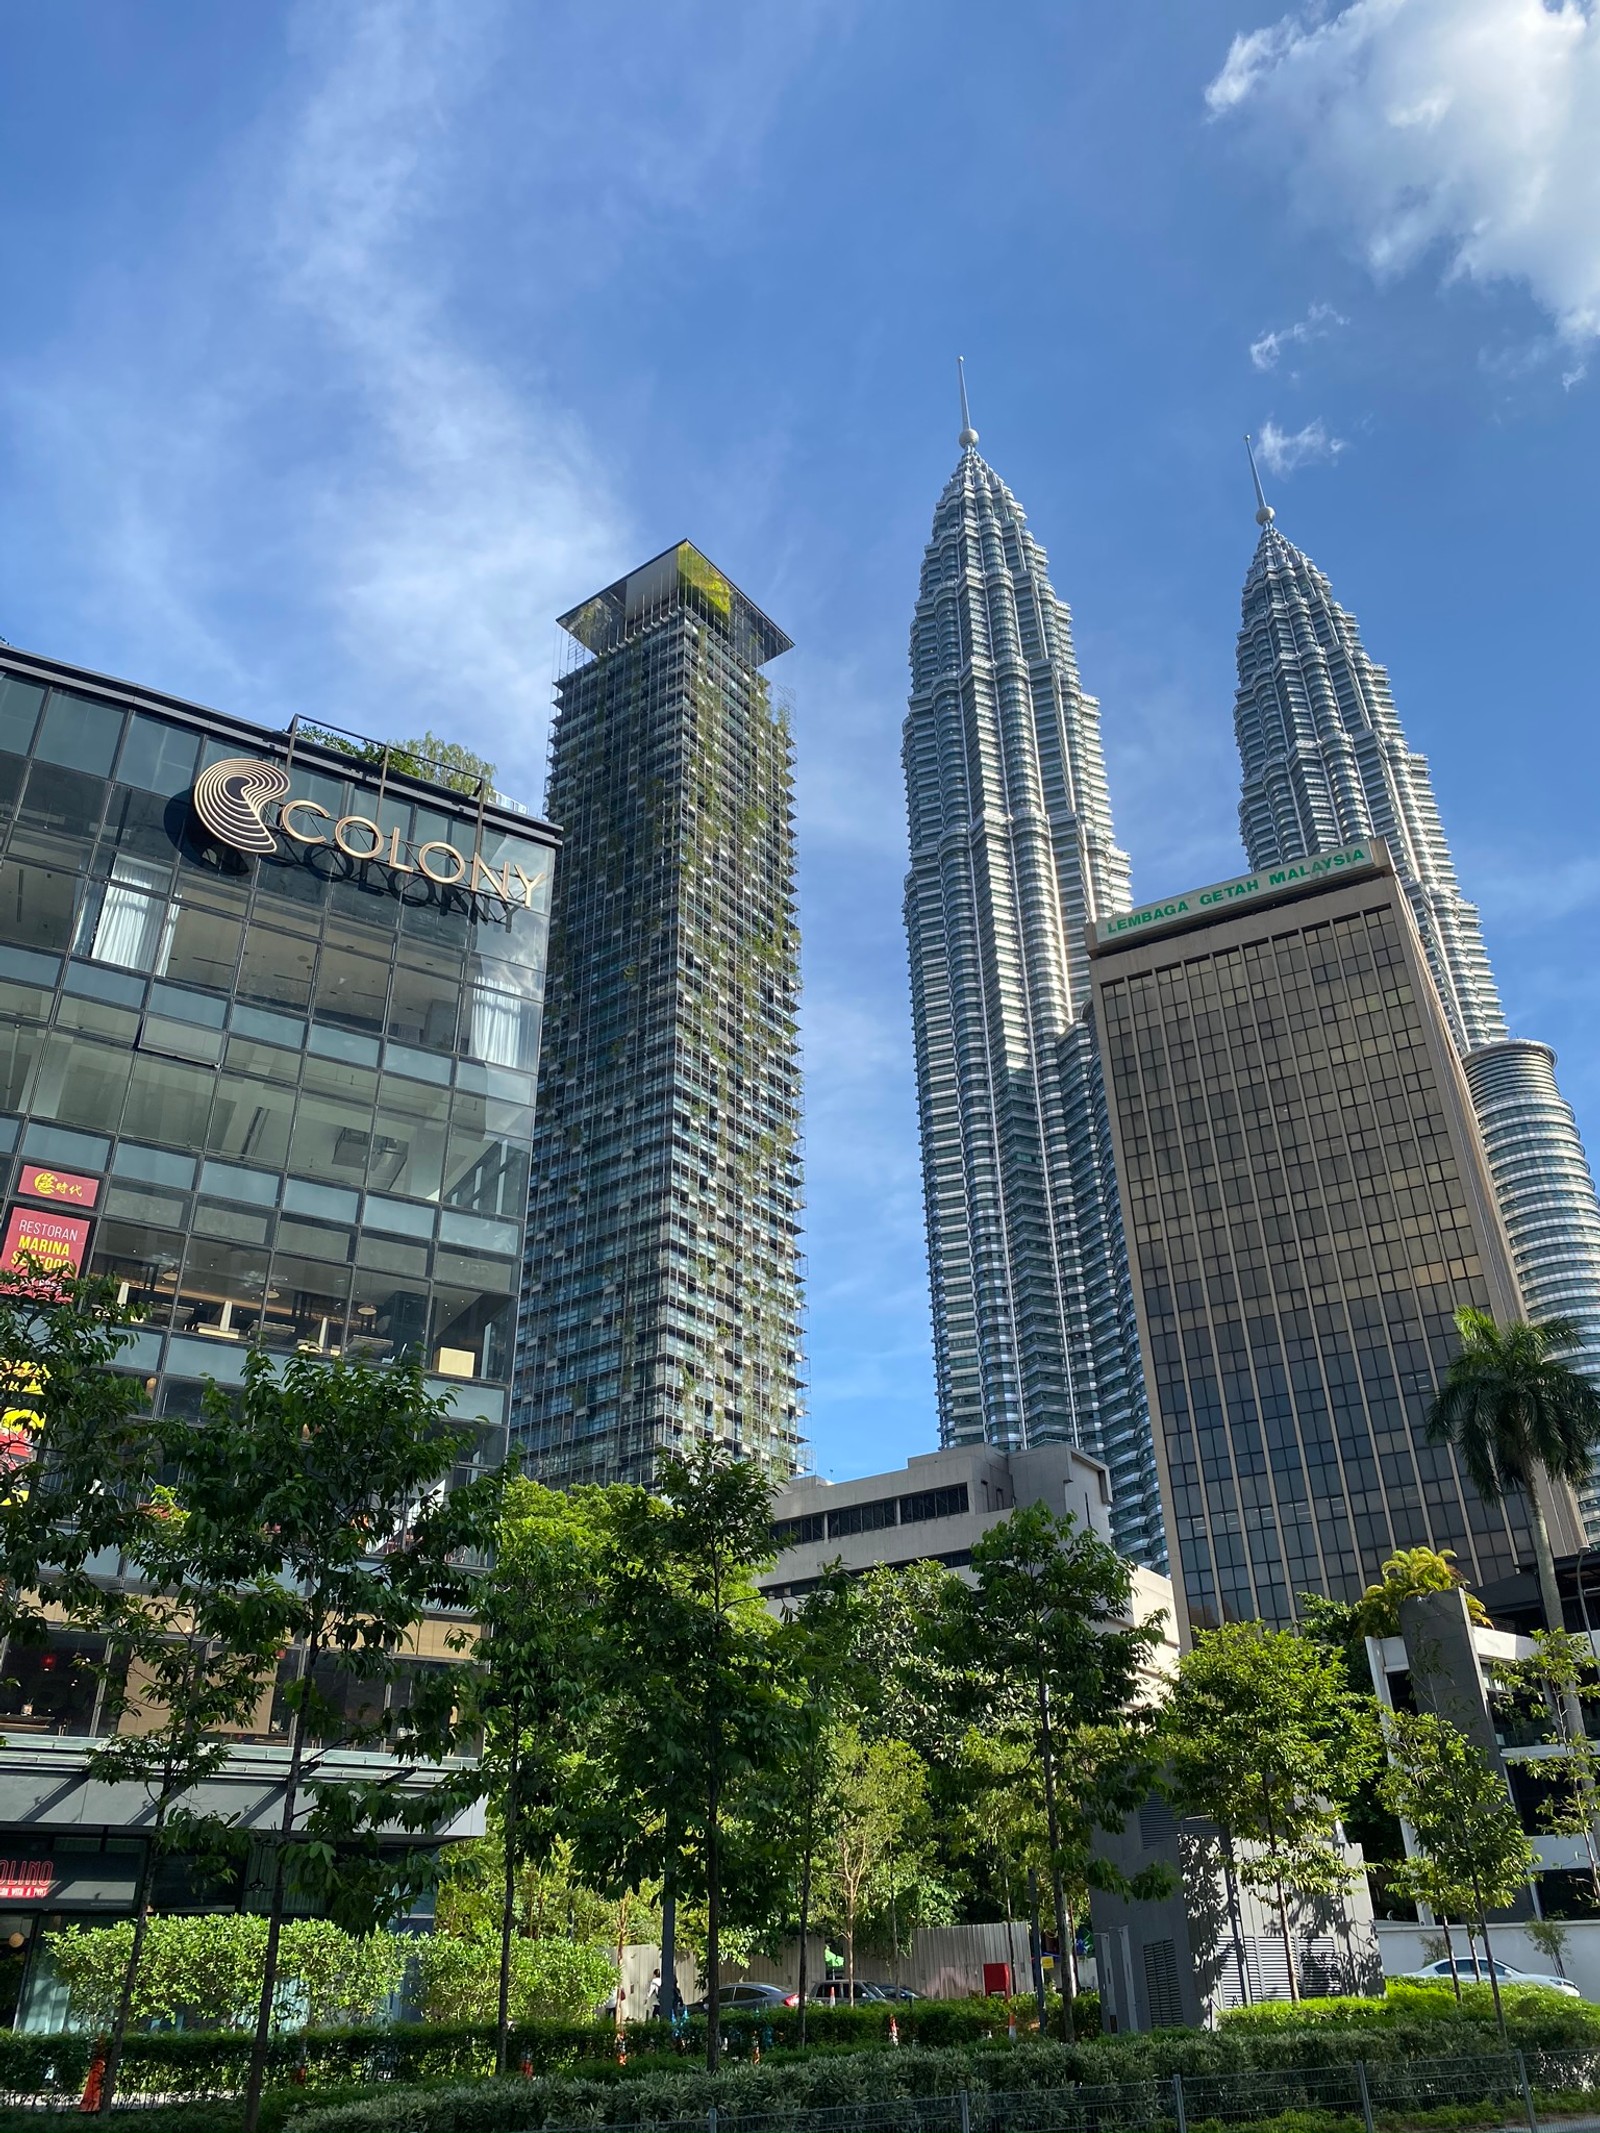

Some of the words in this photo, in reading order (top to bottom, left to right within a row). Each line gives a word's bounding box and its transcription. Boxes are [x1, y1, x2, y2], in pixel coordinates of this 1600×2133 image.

[280, 799, 546, 909] COLONY
[1107, 901, 1189, 933] LEMBAGA
[1199, 879, 1259, 905] GETAH
[1269, 849, 1365, 886] MALAYSIA
[18, 1219, 78, 1241] RESTORAN
[18, 1235, 70, 1257] MARINA
